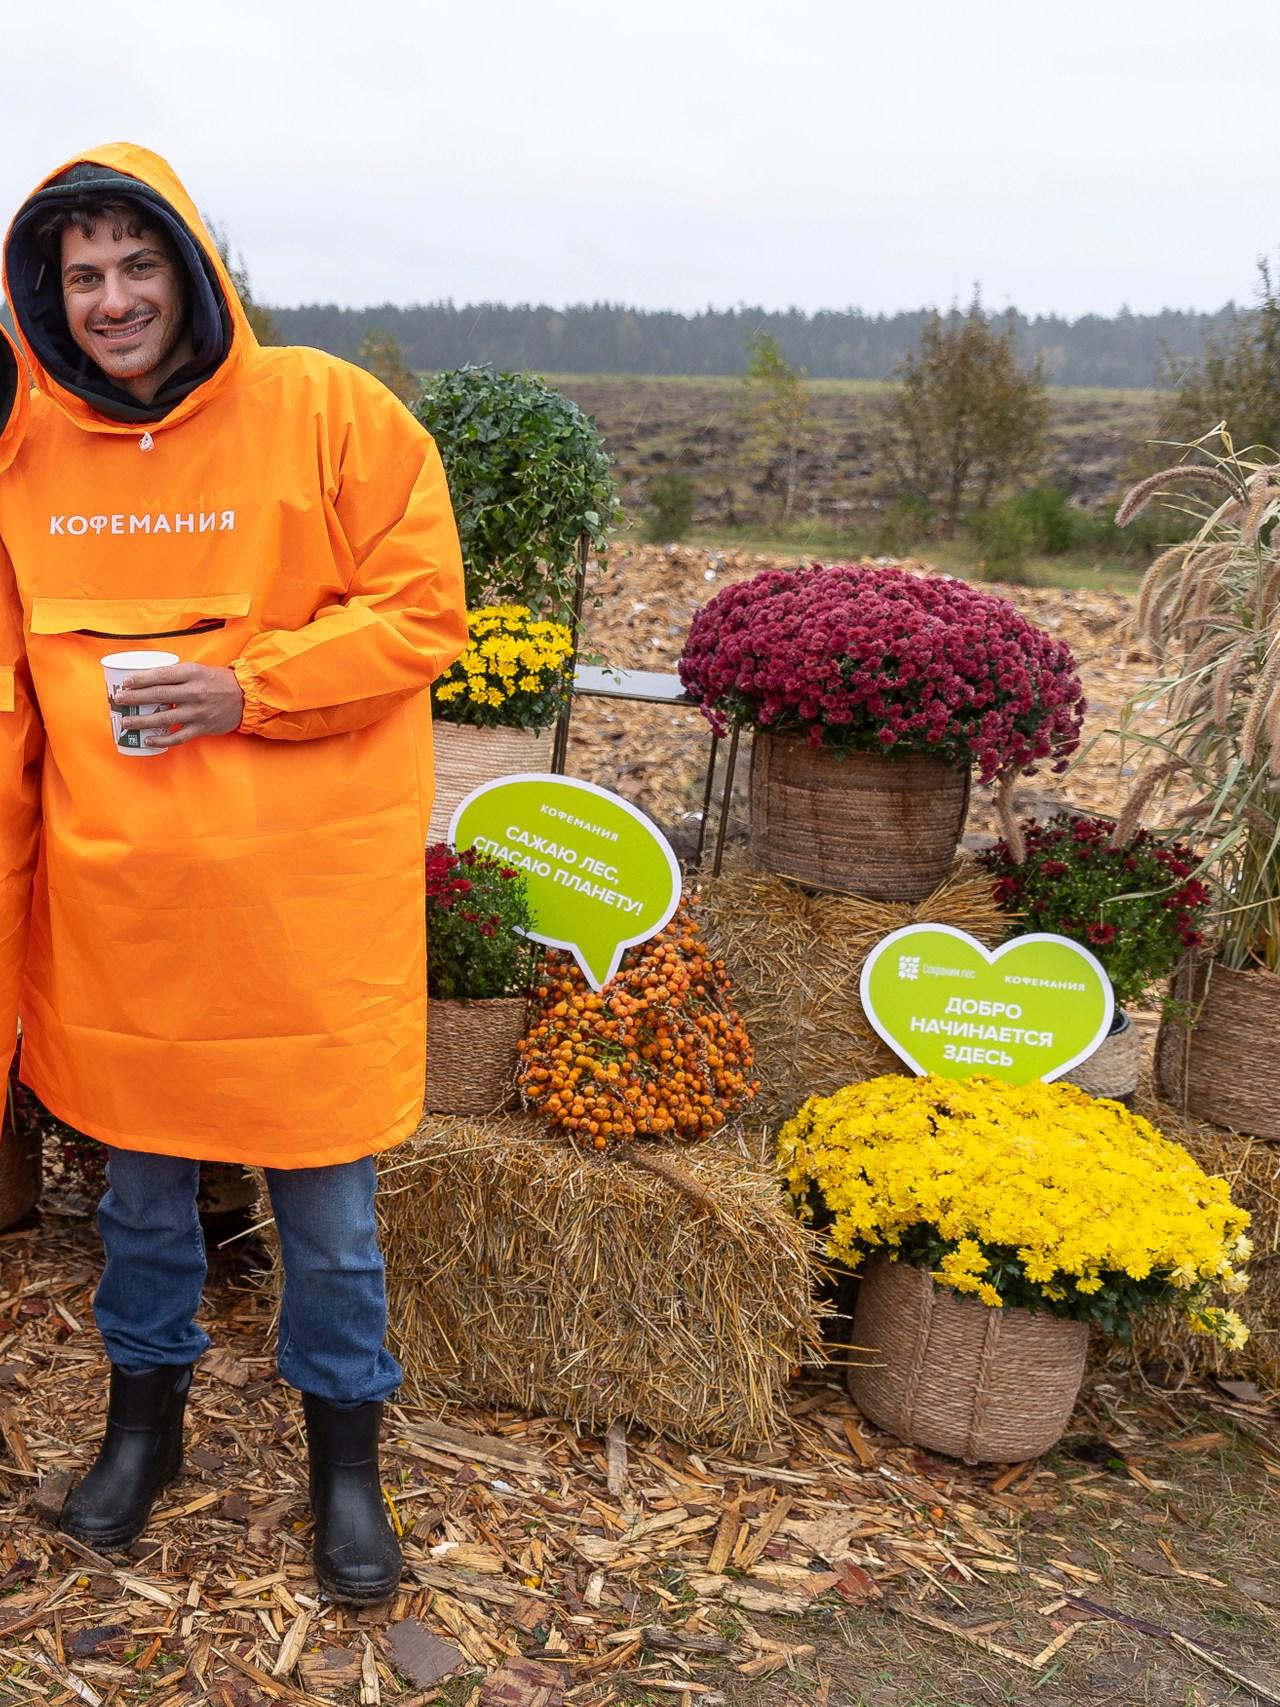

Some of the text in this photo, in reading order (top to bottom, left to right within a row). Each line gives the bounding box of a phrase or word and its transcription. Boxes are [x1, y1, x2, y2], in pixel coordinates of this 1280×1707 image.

[50, 510, 236, 535] КОФЕМАНИЯ
[540, 804, 619, 842] КОФЕМАНИЯ
[505, 826, 620, 885] САЖАЮ ЛЕС,
[473, 836, 644, 917] СПАСАЮ ПЛАНЕТУ!
[1004, 975, 1086, 992] КОФЕМАНИЯ
[945, 997, 1022, 1020] ДОБРО
[910, 1017, 1054, 1047] НАЧИНАЕТСЯ
[943, 1045, 1014, 1067] ЗДЕСЬ
